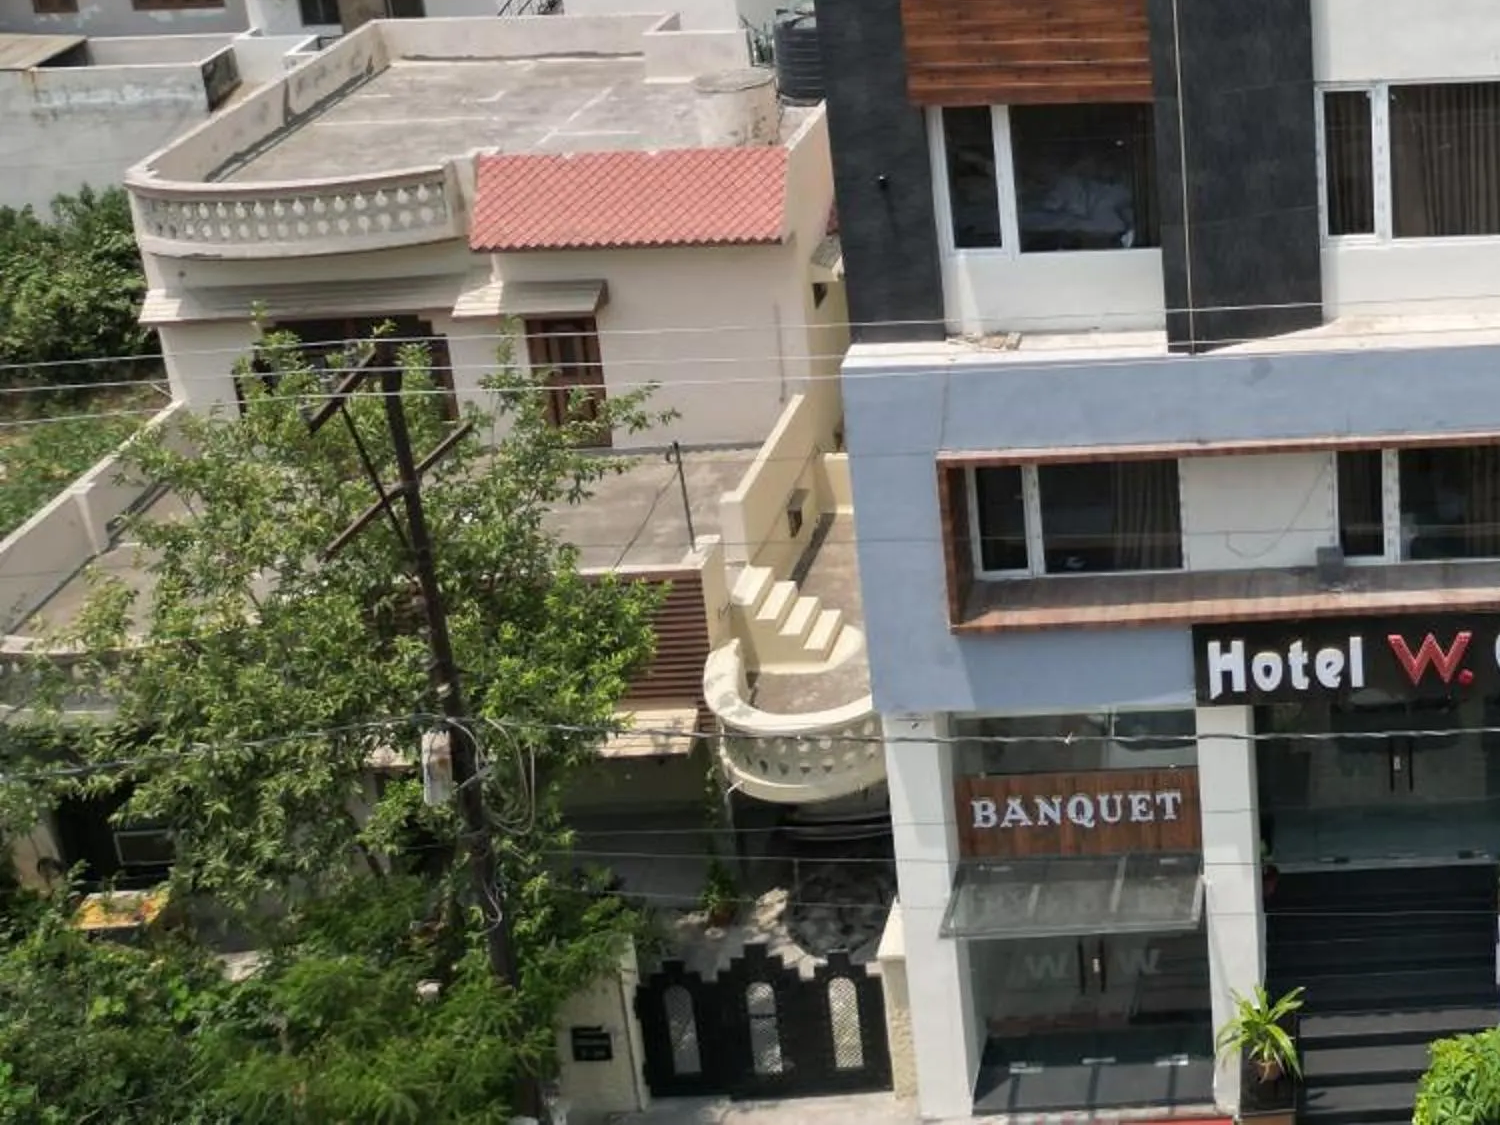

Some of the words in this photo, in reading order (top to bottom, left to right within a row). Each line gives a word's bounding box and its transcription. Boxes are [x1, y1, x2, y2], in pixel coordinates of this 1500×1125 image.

[1207, 636, 1365, 700] Hotel
[1386, 630, 1474, 686] W.
[970, 790, 1183, 829] BANQUET
